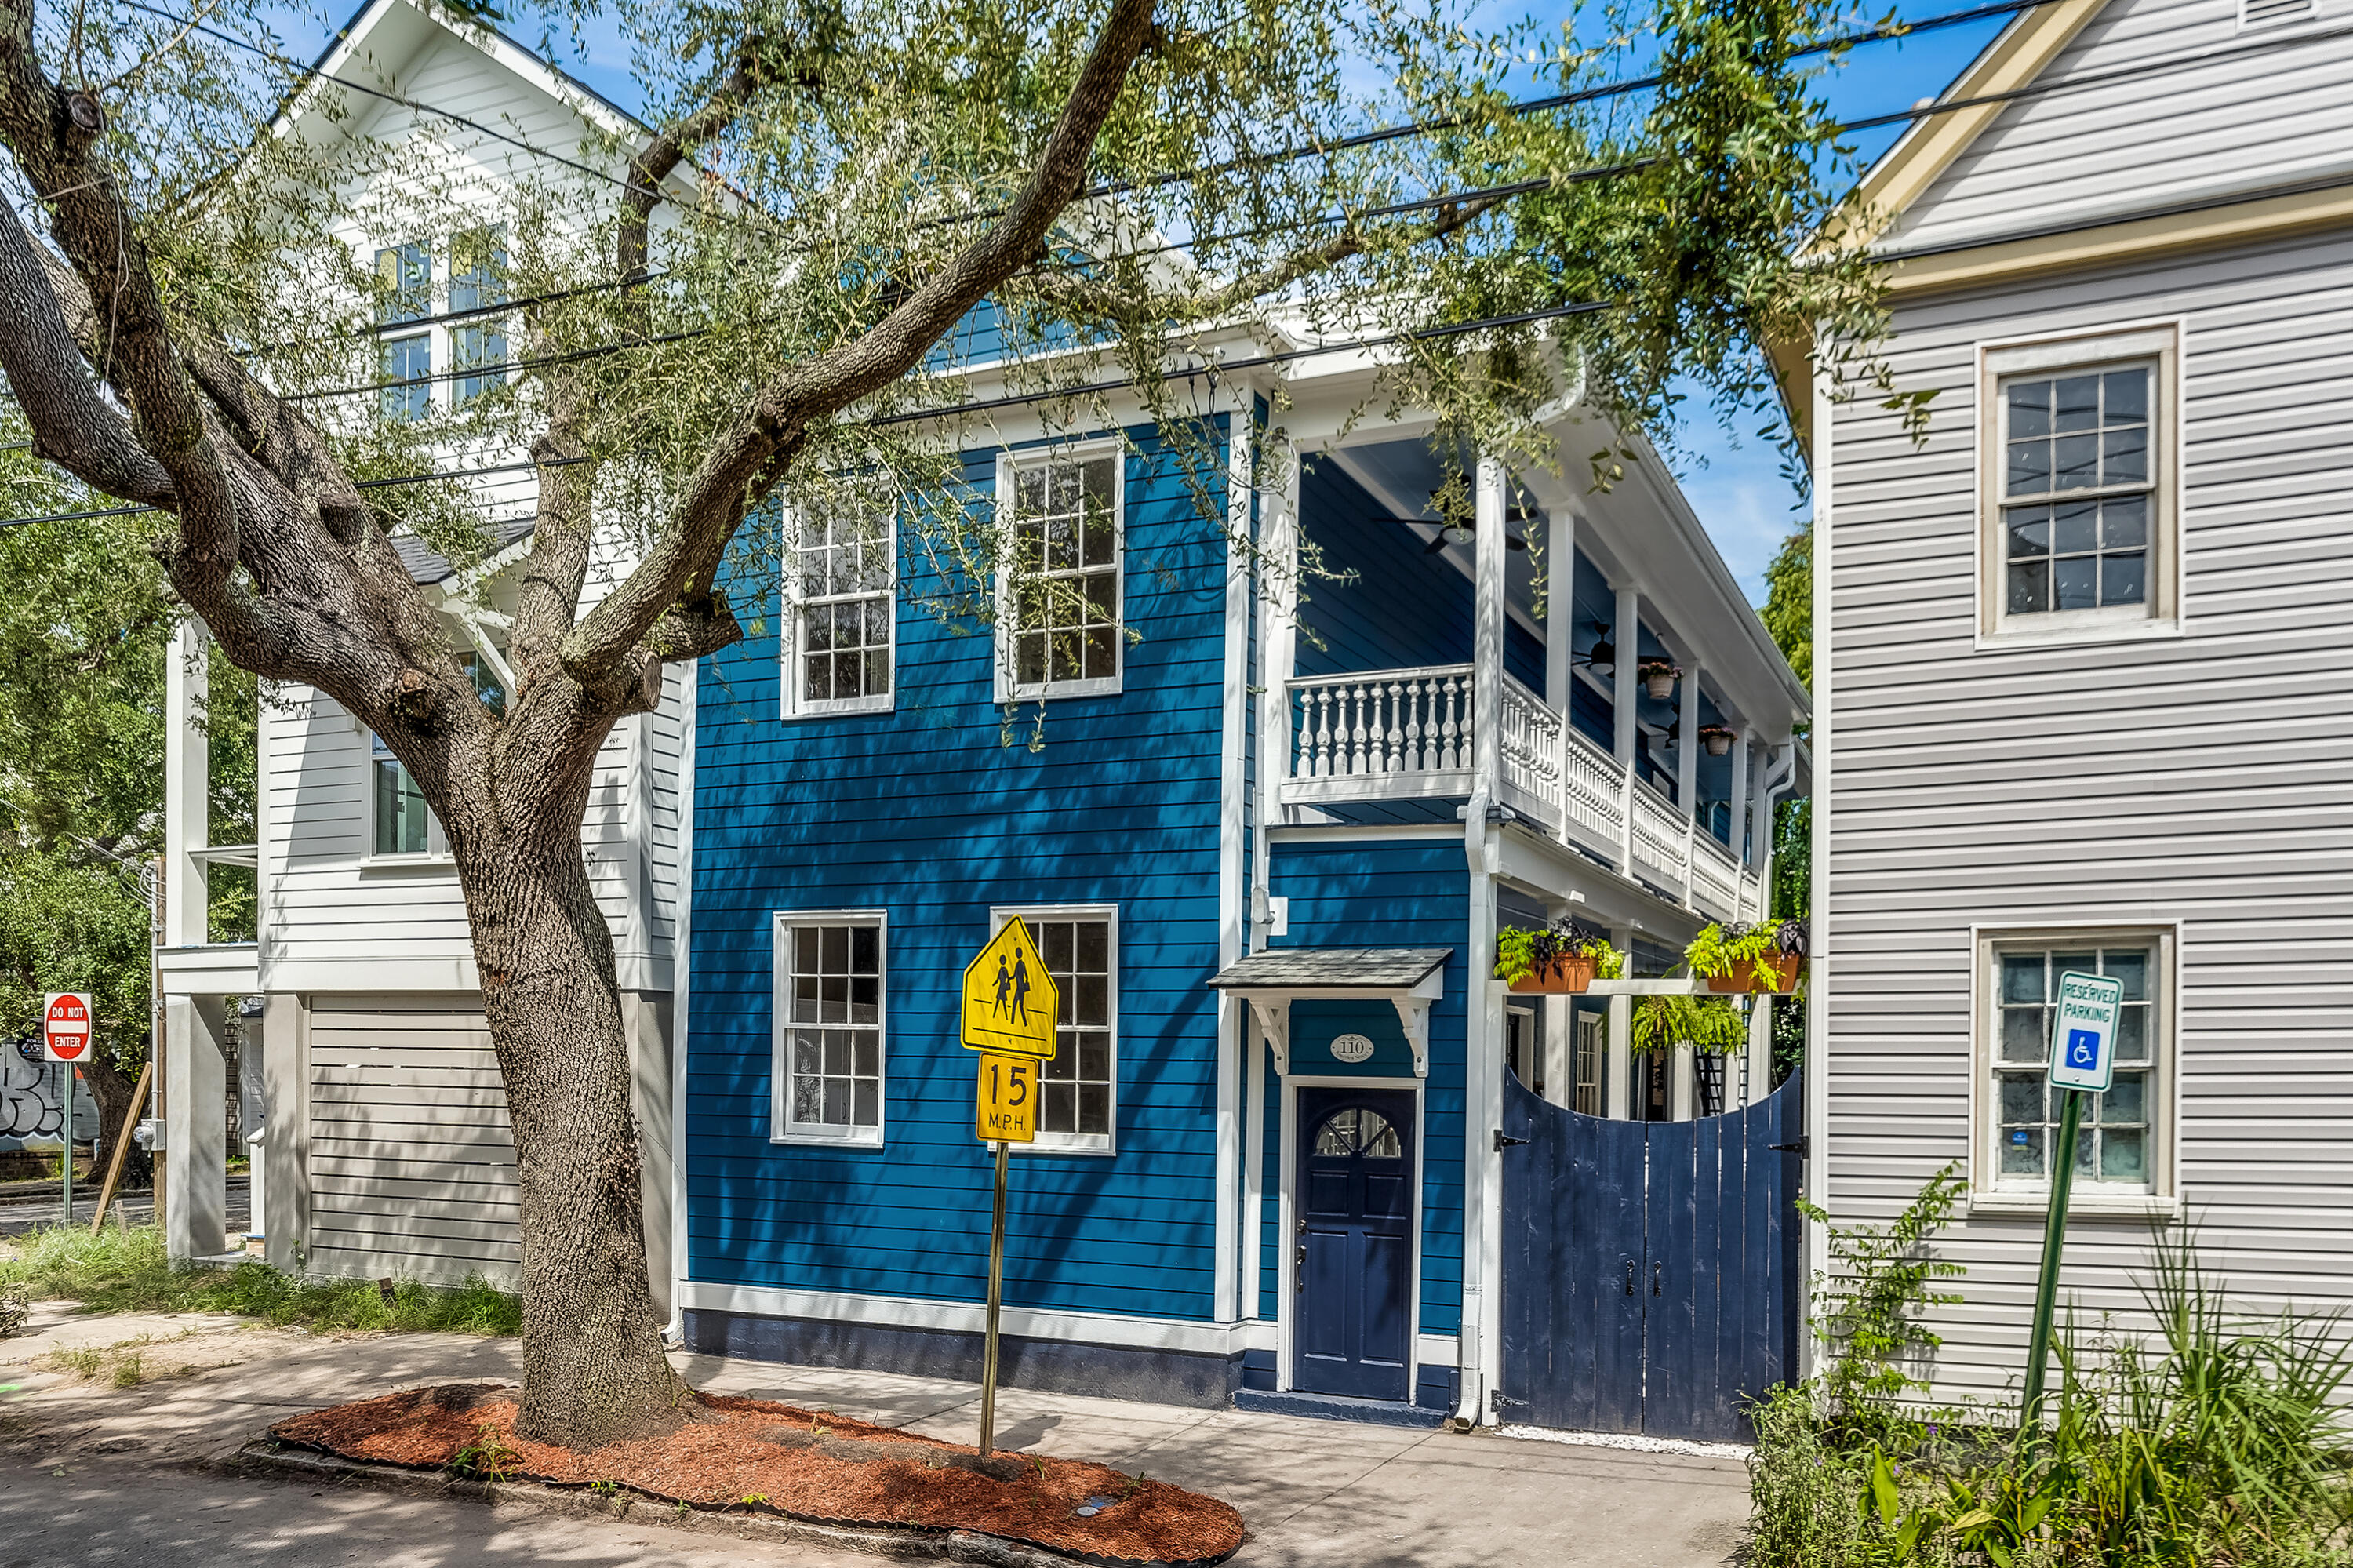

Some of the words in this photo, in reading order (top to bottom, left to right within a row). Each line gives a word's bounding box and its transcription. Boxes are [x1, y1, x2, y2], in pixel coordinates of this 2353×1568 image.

[2063, 983, 2116, 1004] RESERVED
[52, 1006, 64, 1018] DO
[67, 1006, 84, 1018] NOT
[2064, 1003, 2111, 1023] PARKING
[54, 1036, 81, 1047] ENTER
[1340, 1041, 1364, 1054] 110
[991, 1064, 1027, 1106] 15
